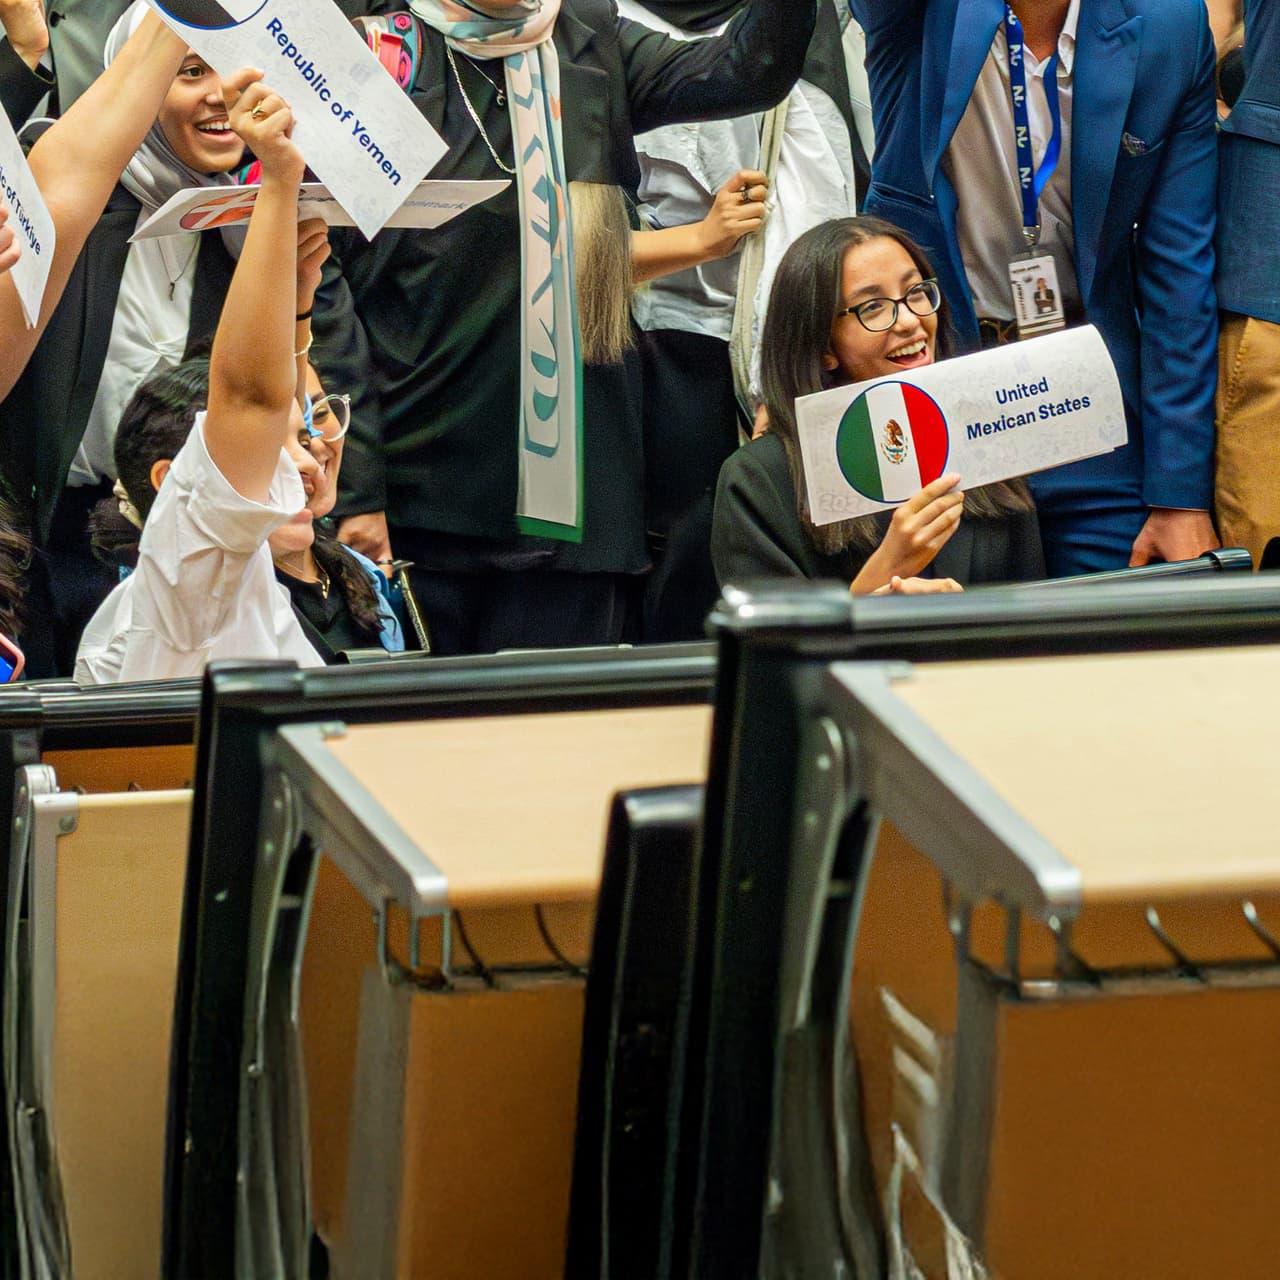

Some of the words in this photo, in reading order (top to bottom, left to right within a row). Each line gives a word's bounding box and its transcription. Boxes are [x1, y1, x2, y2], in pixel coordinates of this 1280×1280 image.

[266, 17, 331, 102] Republic
[331, 102, 354, 122] of
[352, 119, 402, 186] Yemen
[6, 186, 16, 204] of
[996, 377, 1049, 405] United
[967, 411, 1036, 440] Mexican
[1039, 395, 1091, 420] States
